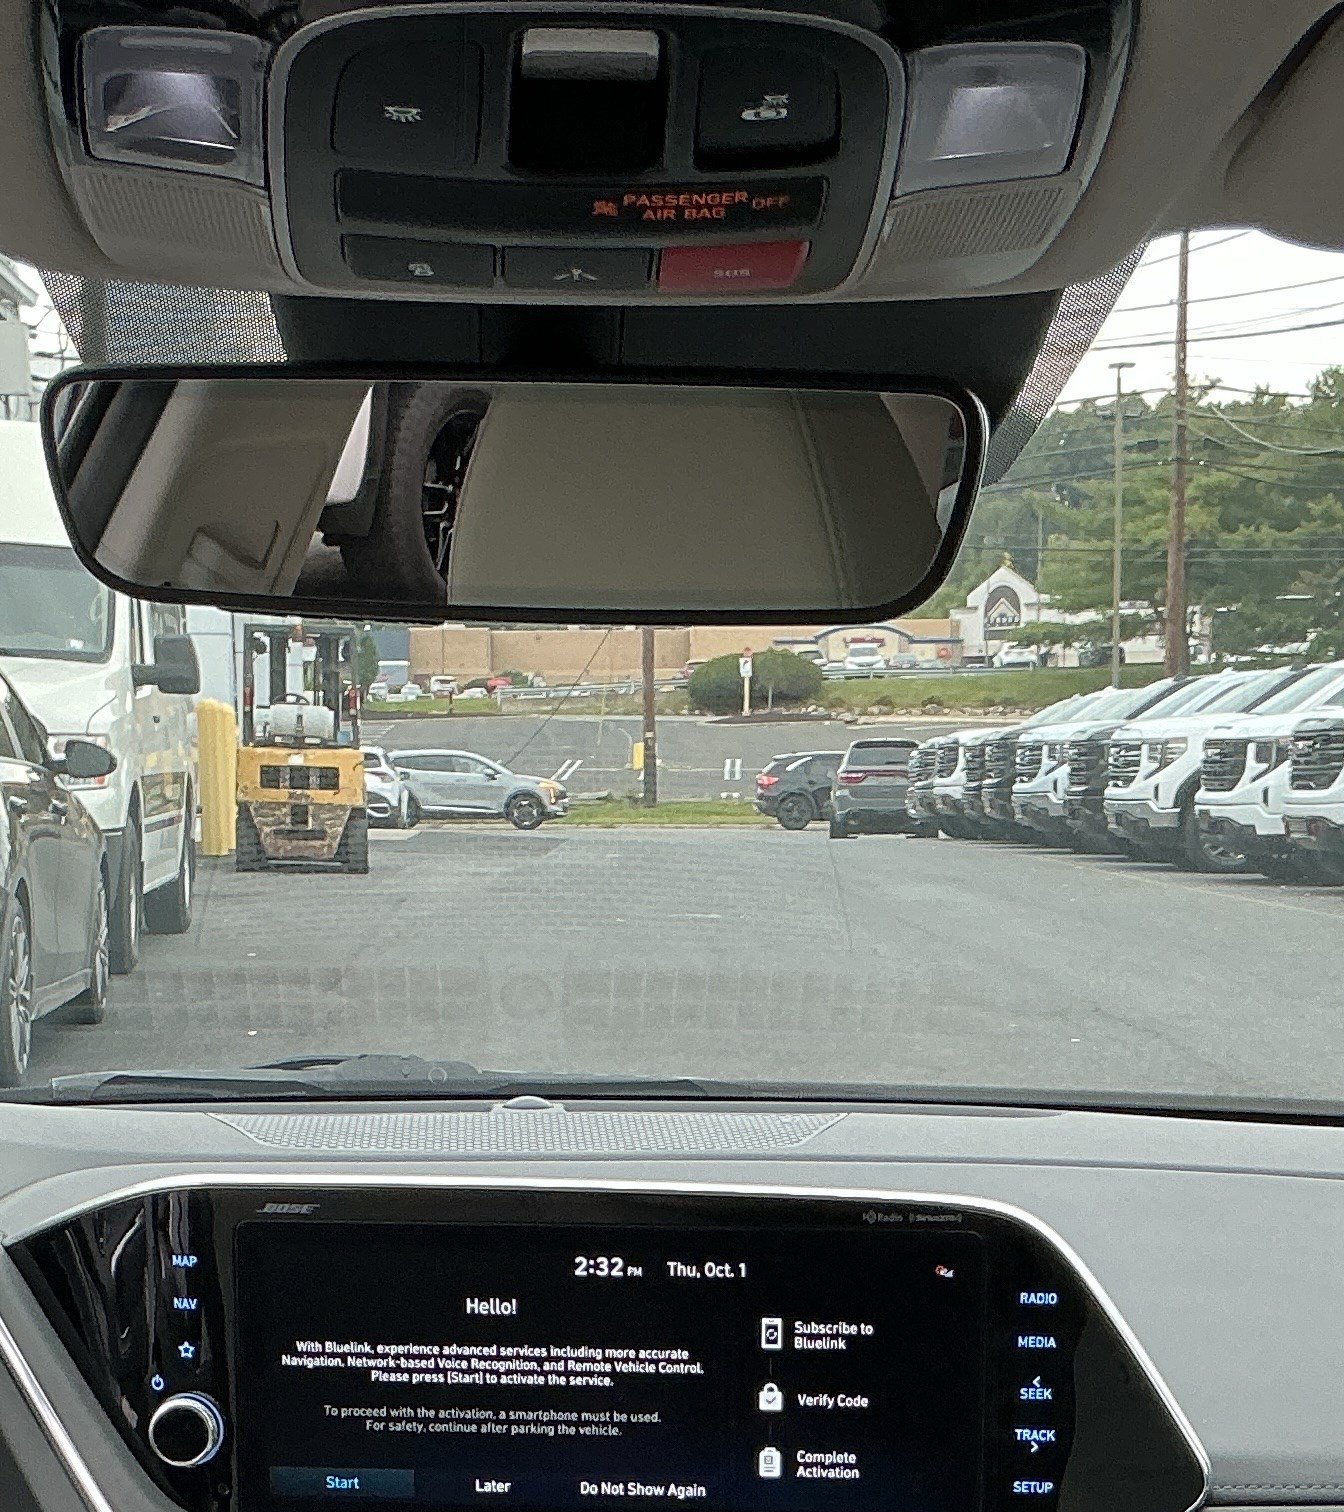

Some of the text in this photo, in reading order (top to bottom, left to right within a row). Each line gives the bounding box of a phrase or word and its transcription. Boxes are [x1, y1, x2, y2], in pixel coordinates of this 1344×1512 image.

[623, 191, 791, 211] PASSENGER OFF
[642, 207, 726, 221] AIR BAG
[171, 1255, 198, 1268] MAP
[574, 1256, 643, 1277] 2:32 PM
[667, 1261, 747, 1278] Thu, Oct. 1
[173, 1297, 198, 1310] NAV
[1019, 1292, 1058, 1305] RADIO
[465, 1297, 517, 1316] Hello!
[794, 1321, 874, 1336] Subscribe to
[794, 1336, 847, 1350] Bluelink
[1017, 1335, 1057, 1349] MEDIA
[295, 1340, 689, 1360] With Bluelink, experience advanced services including more accurate
[281, 1355, 705, 1375] Navigation, Network-based Voice Recognition, and Remote Vehicle Control.
[370, 1370, 615, 1387] Please press [Start] to activate the service.
[797, 1393, 869, 1409] Verify Code
[1019, 1388, 1053, 1400] SEEK
[323, 1404, 339, 1416] To
[341, 1405, 387, 1419] proceed
[389, 1406, 415, 1418] with
[417, 1407, 436, 1418] the
[498, 1410, 506, 1420] a
[508, 1409, 579, 1422] smartphone
[581, 1410, 611, 1422] must
[613, 1410, 628, 1423] be
[630, 1411, 662, 1423] used.
[365, 1419, 623, 1436] For safety, continue after parking the vehicle.
[1014, 1428, 1056, 1441] TRACK
[796, 1450, 857, 1465] Complete
[796, 1465, 860, 1479] Activation
[325, 1475, 360, 1489] Start
[475, 1478, 511, 1493] Later
[1012, 1480, 1054, 1494] SETUP
[580, 1481, 707, 1500] Do Not Show Again
